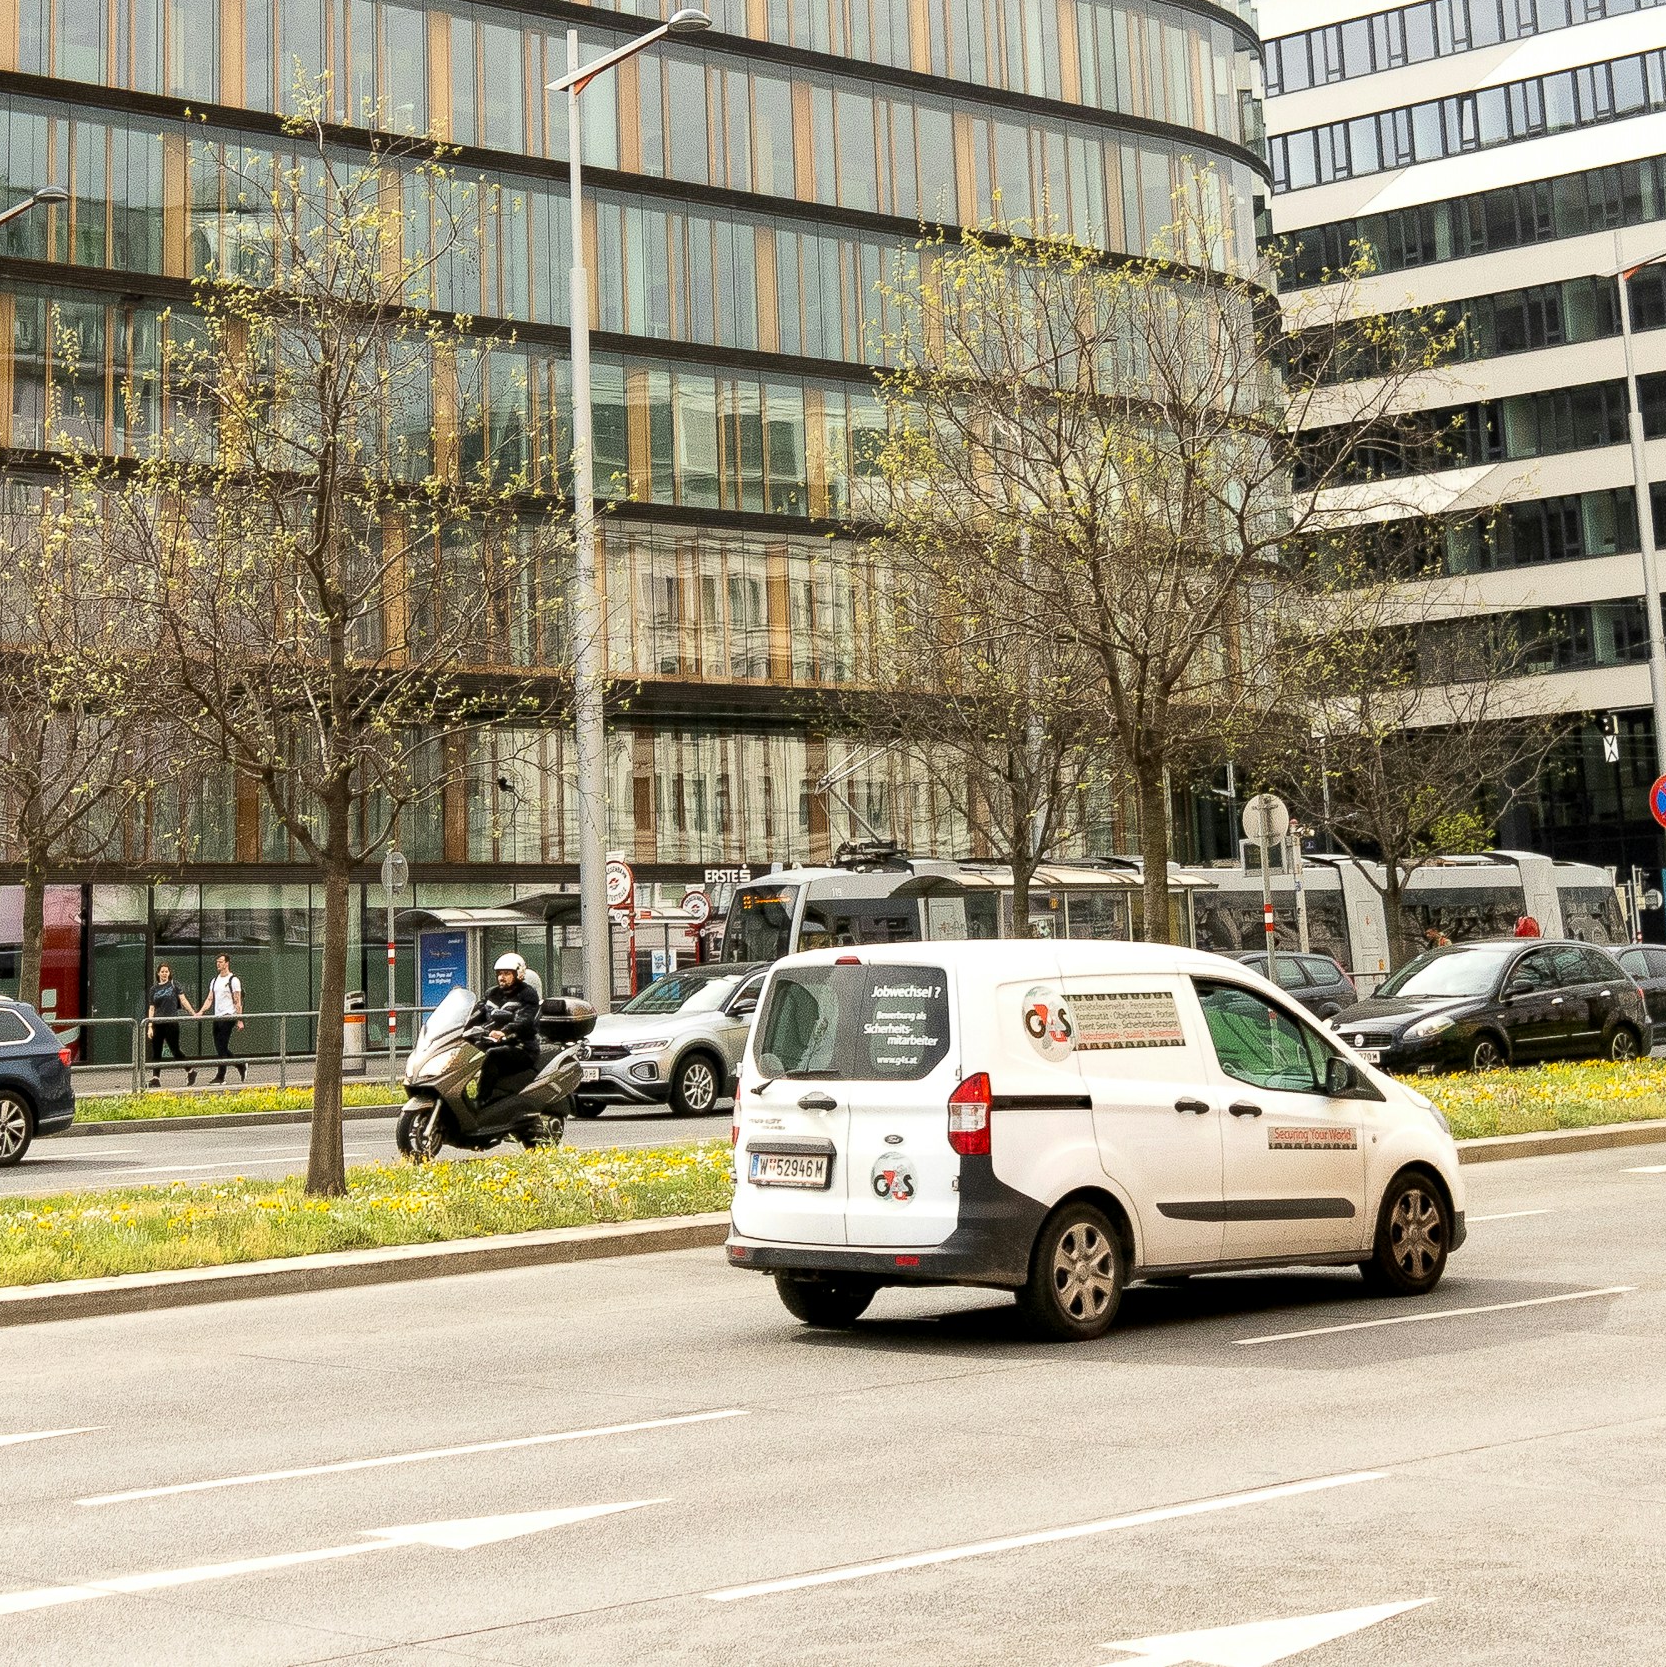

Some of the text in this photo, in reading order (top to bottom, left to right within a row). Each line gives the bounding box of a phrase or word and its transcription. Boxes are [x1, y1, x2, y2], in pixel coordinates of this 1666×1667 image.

[704, 869, 739, 883] ERSTE
[871, 985, 942, 998] Jobwechsel ?
[876, 1010, 927, 1022] Bewerbung als
[1025, 1003, 1072, 1042] G4S
[863, 1023, 913, 1034] Sicherheits-
[1078, 1022, 1095, 1030] Event
[1096, 1021, 1117, 1030] Service
[887, 1035, 939, 1046] mitarbeiter
[1274, 1127, 1351, 1143] Securing Your World
[760, 1159, 768, 1175] W
[776, 1158, 813, 1178] 52946
[873, 1170, 915, 1201] G4S
